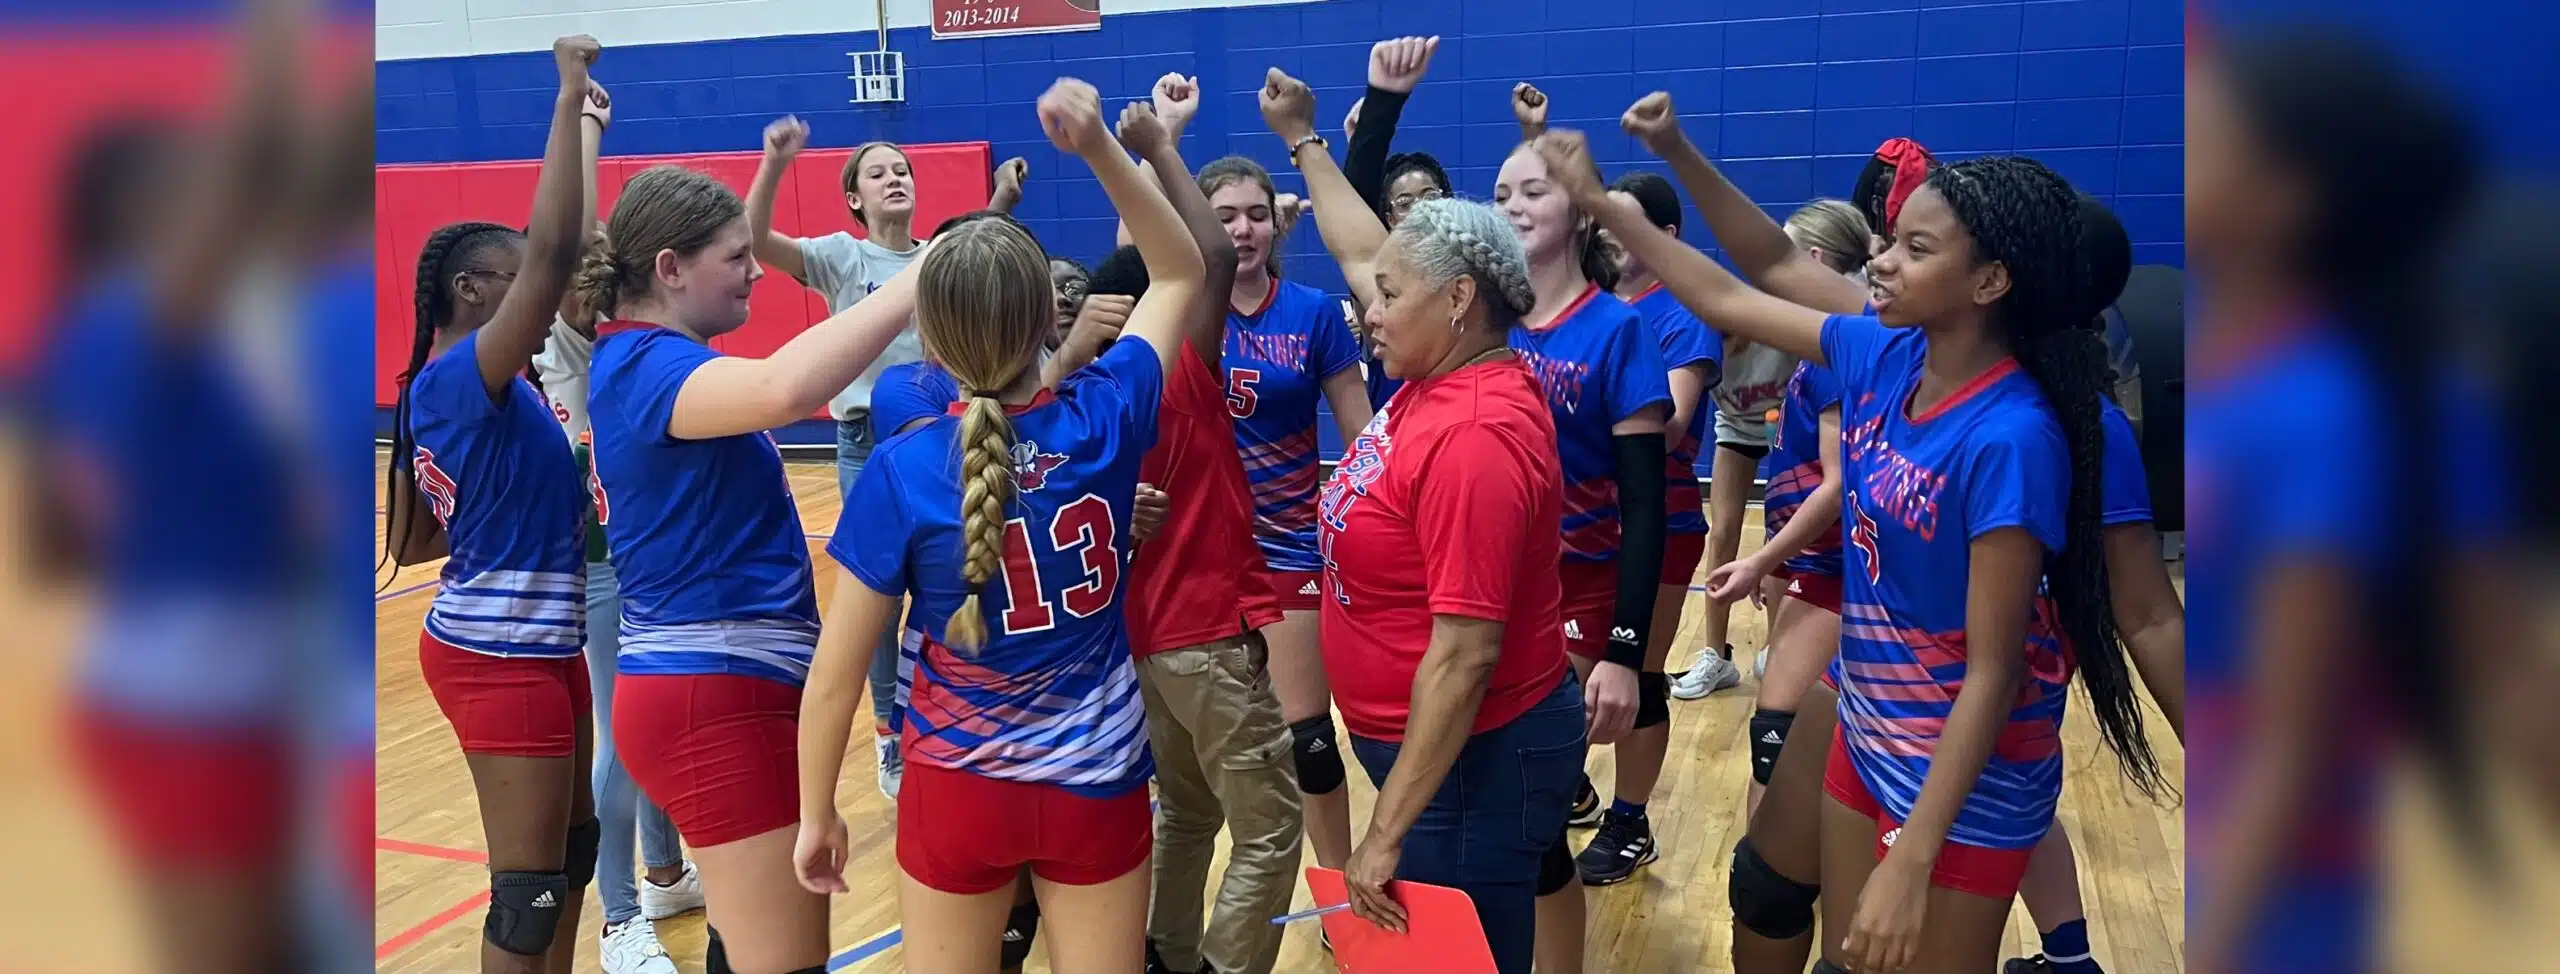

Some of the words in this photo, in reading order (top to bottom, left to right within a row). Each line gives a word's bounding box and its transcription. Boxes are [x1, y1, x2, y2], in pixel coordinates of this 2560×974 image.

[943, 6, 1020, 27] 2013-2014
[1226, 367, 1260, 419] 5
[999, 492, 1120, 636] 13
